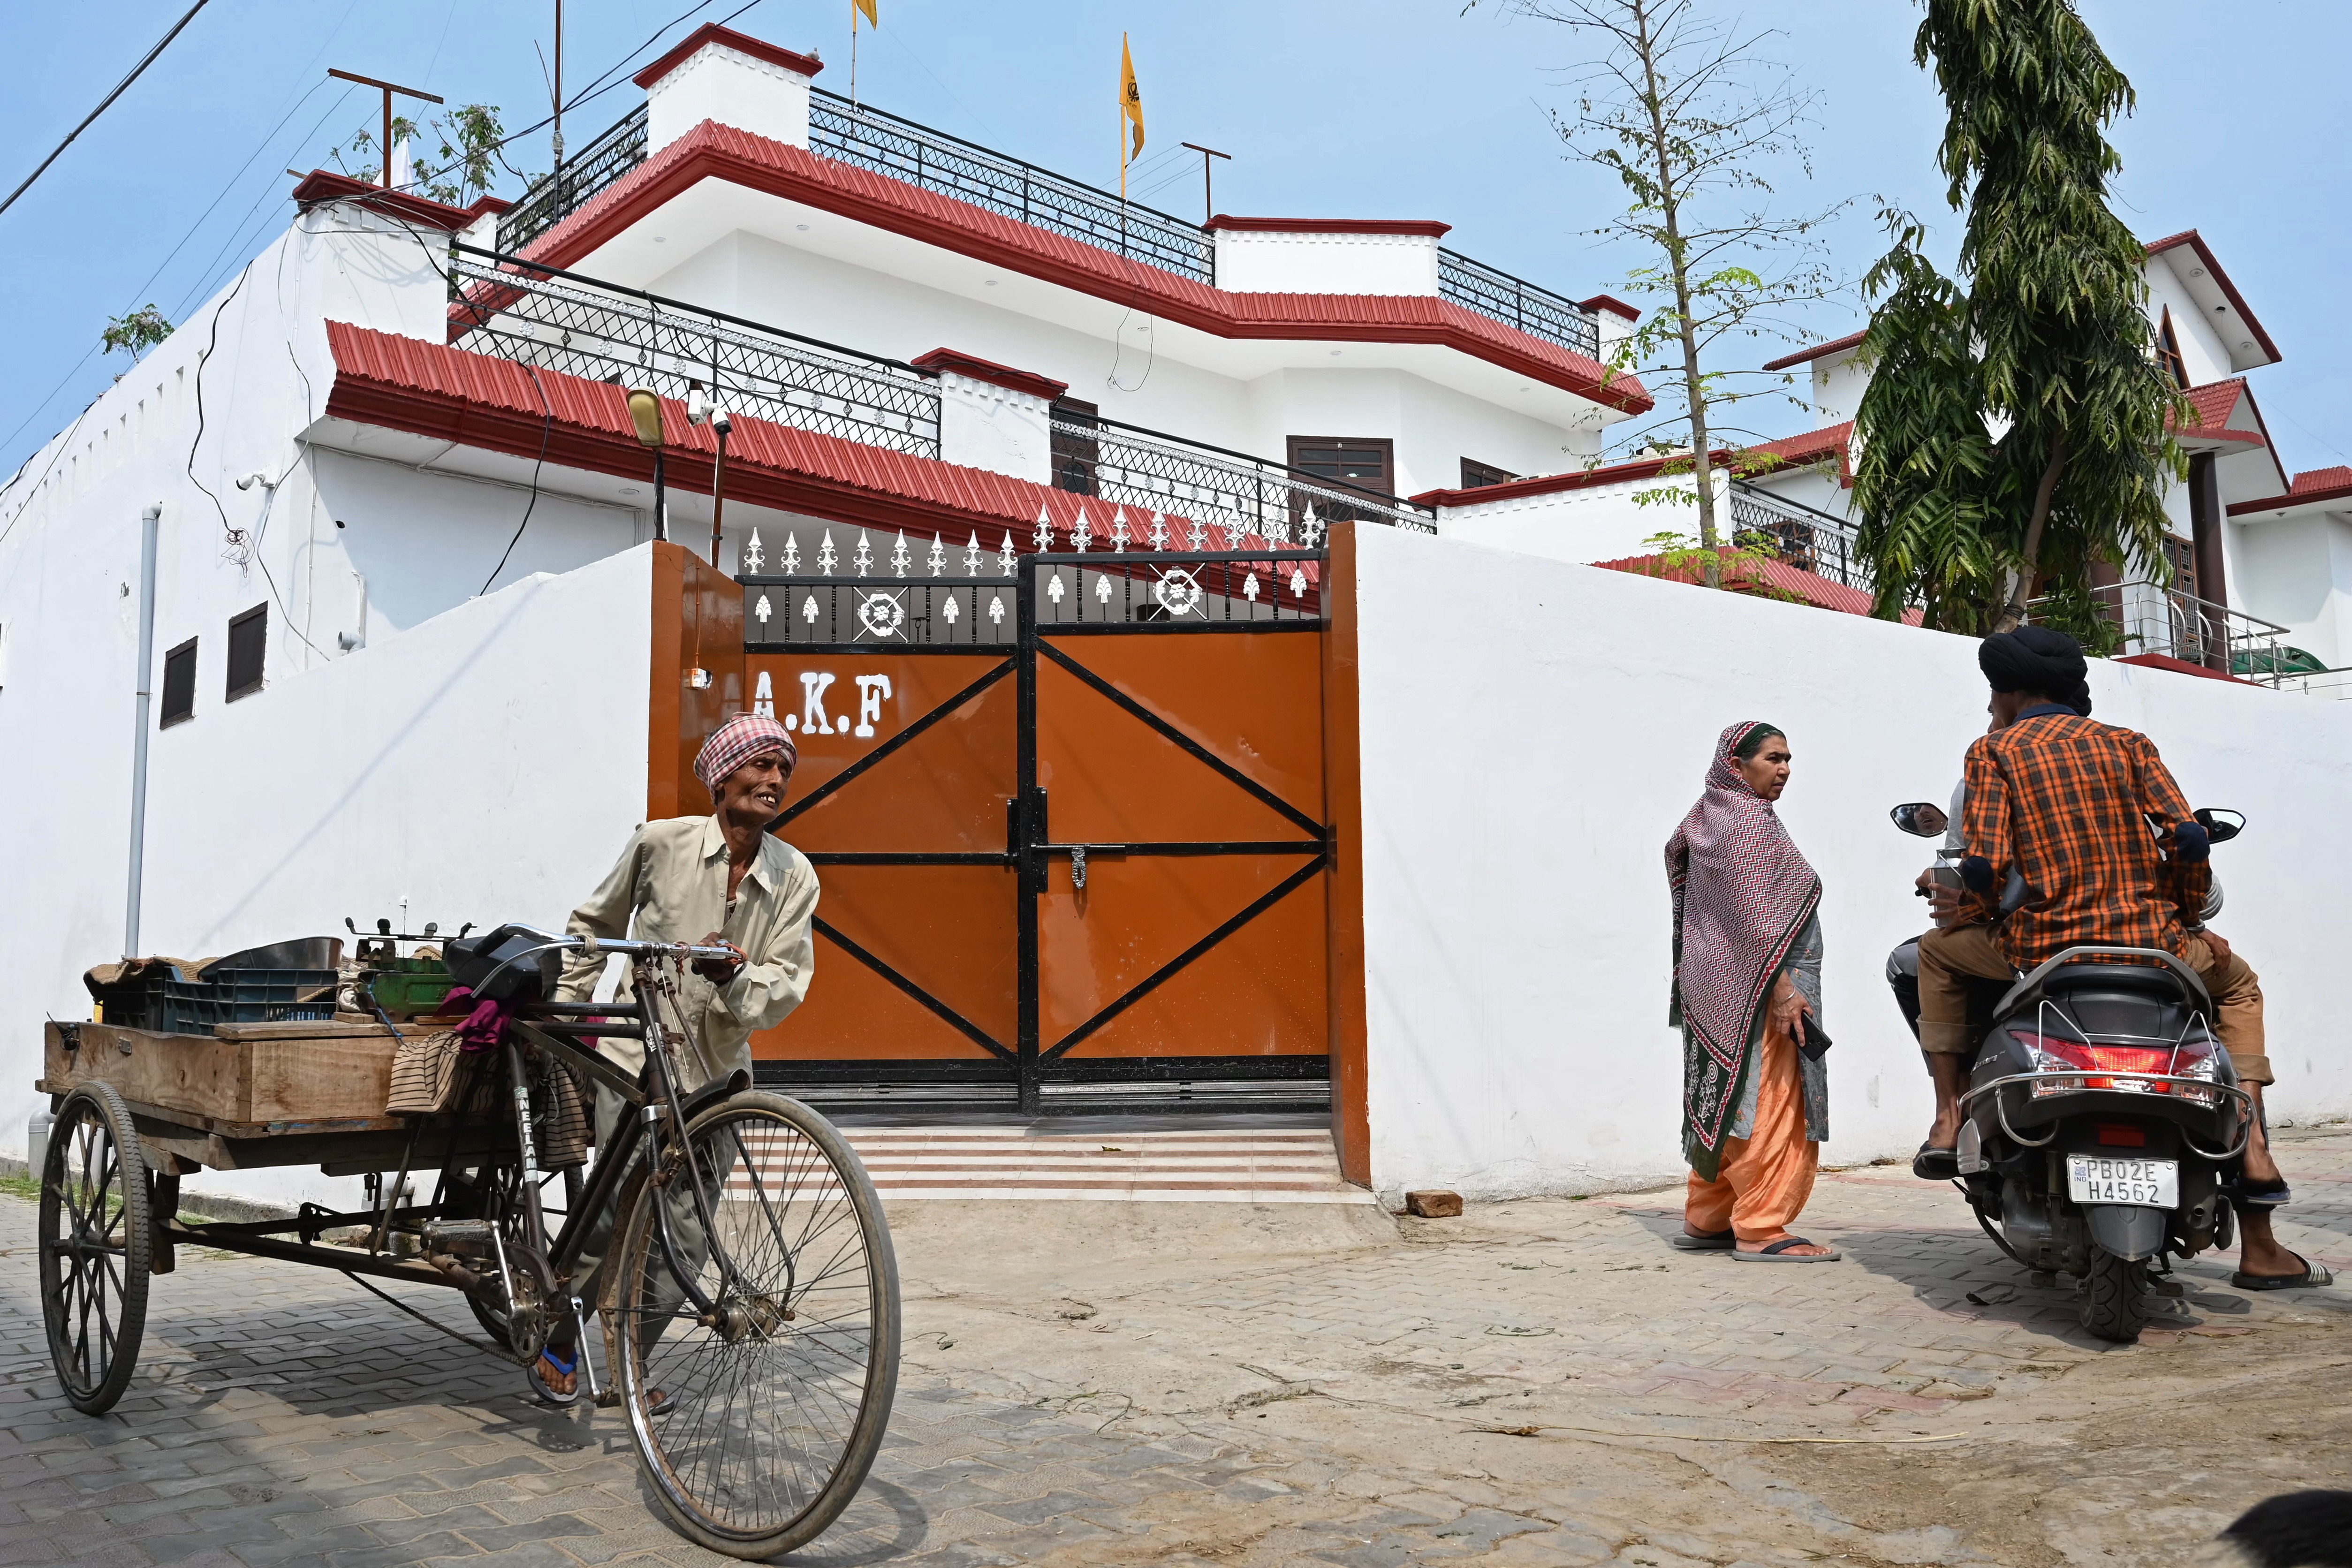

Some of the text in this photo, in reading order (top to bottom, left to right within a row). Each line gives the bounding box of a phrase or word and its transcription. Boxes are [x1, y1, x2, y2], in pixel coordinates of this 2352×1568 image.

[754, 671, 891, 737] A.K.F
[519, 1099, 537, 1169] NEELAM
[2086, 1159, 2156, 1181] PB02E
[2089, 1181, 2159, 1203] H4562
